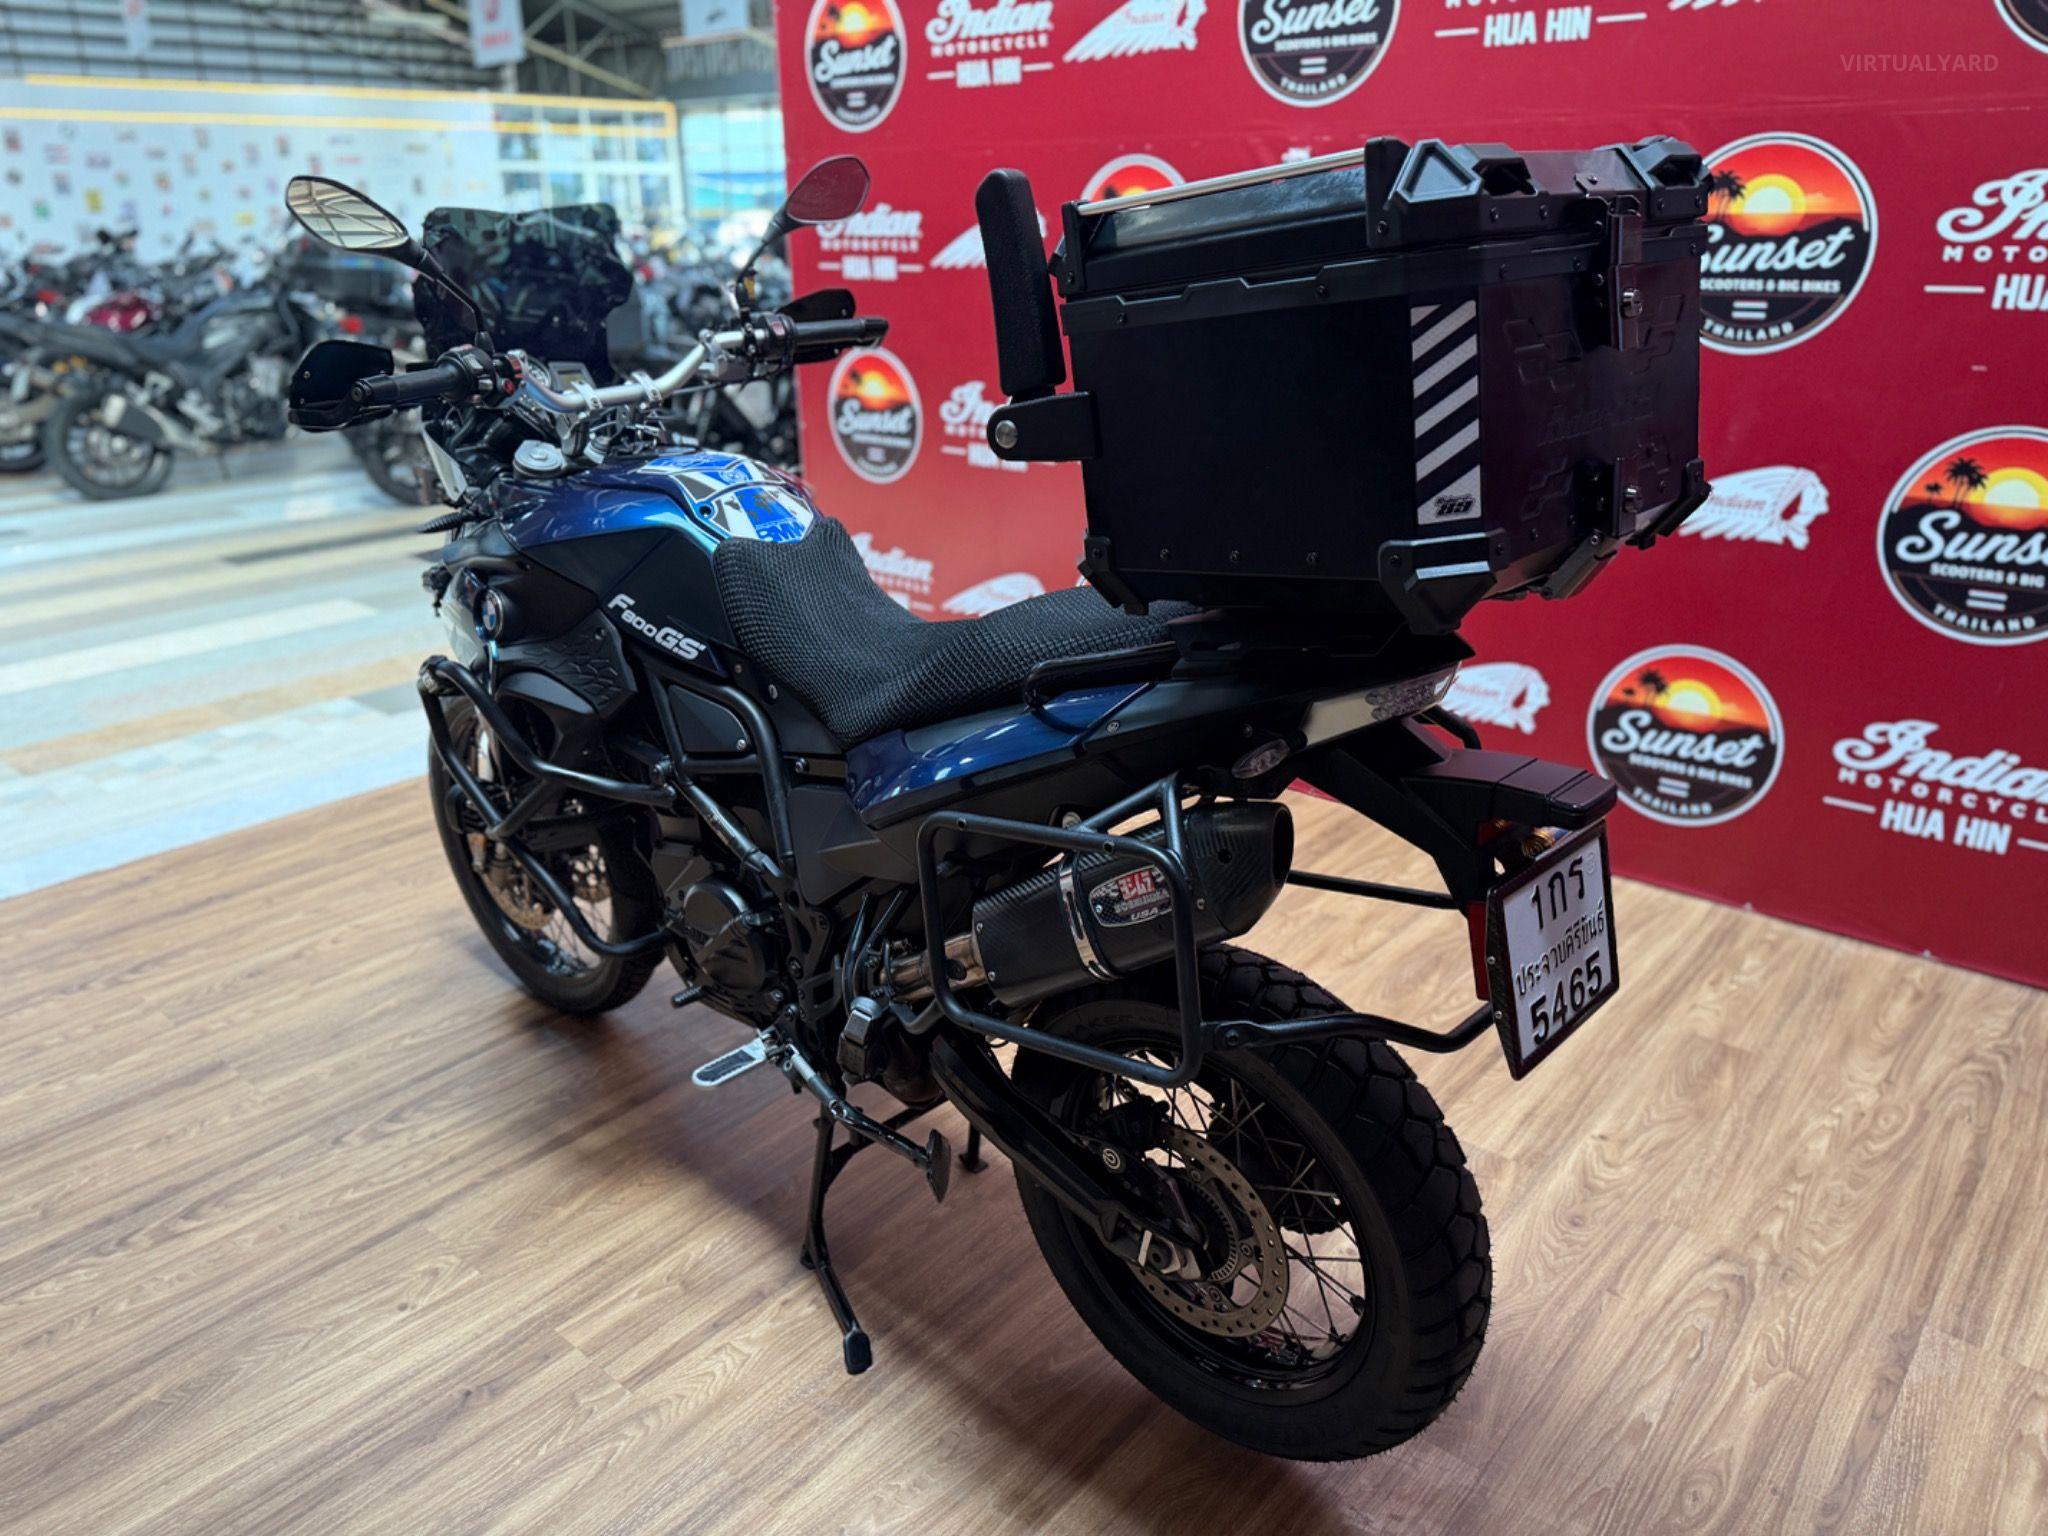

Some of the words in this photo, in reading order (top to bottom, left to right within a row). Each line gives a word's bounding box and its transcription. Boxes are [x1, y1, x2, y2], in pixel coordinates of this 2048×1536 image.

[1484, 11, 1536, 47] HUA
[1545, 5, 1592, 42] HIN
[1704, 318, 1794, 341] THAILAND
[1896, 509, 2048, 566] Suns
[1930, 562, 2004, 582] SCOOTERS
[2019, 574, 2046, 588] BIG
[1934, 603, 2037, 633] THAILAND
[1602, 709, 1765, 768] Sunset
[1833, 719, 2048, 803] India
[1633, 786, 1713, 816] THAILAND
[1880, 799, 1945, 841] HUA
[1953, 815, 2013, 856] HIN
[1530, 949, 1602, 1046] 5465
